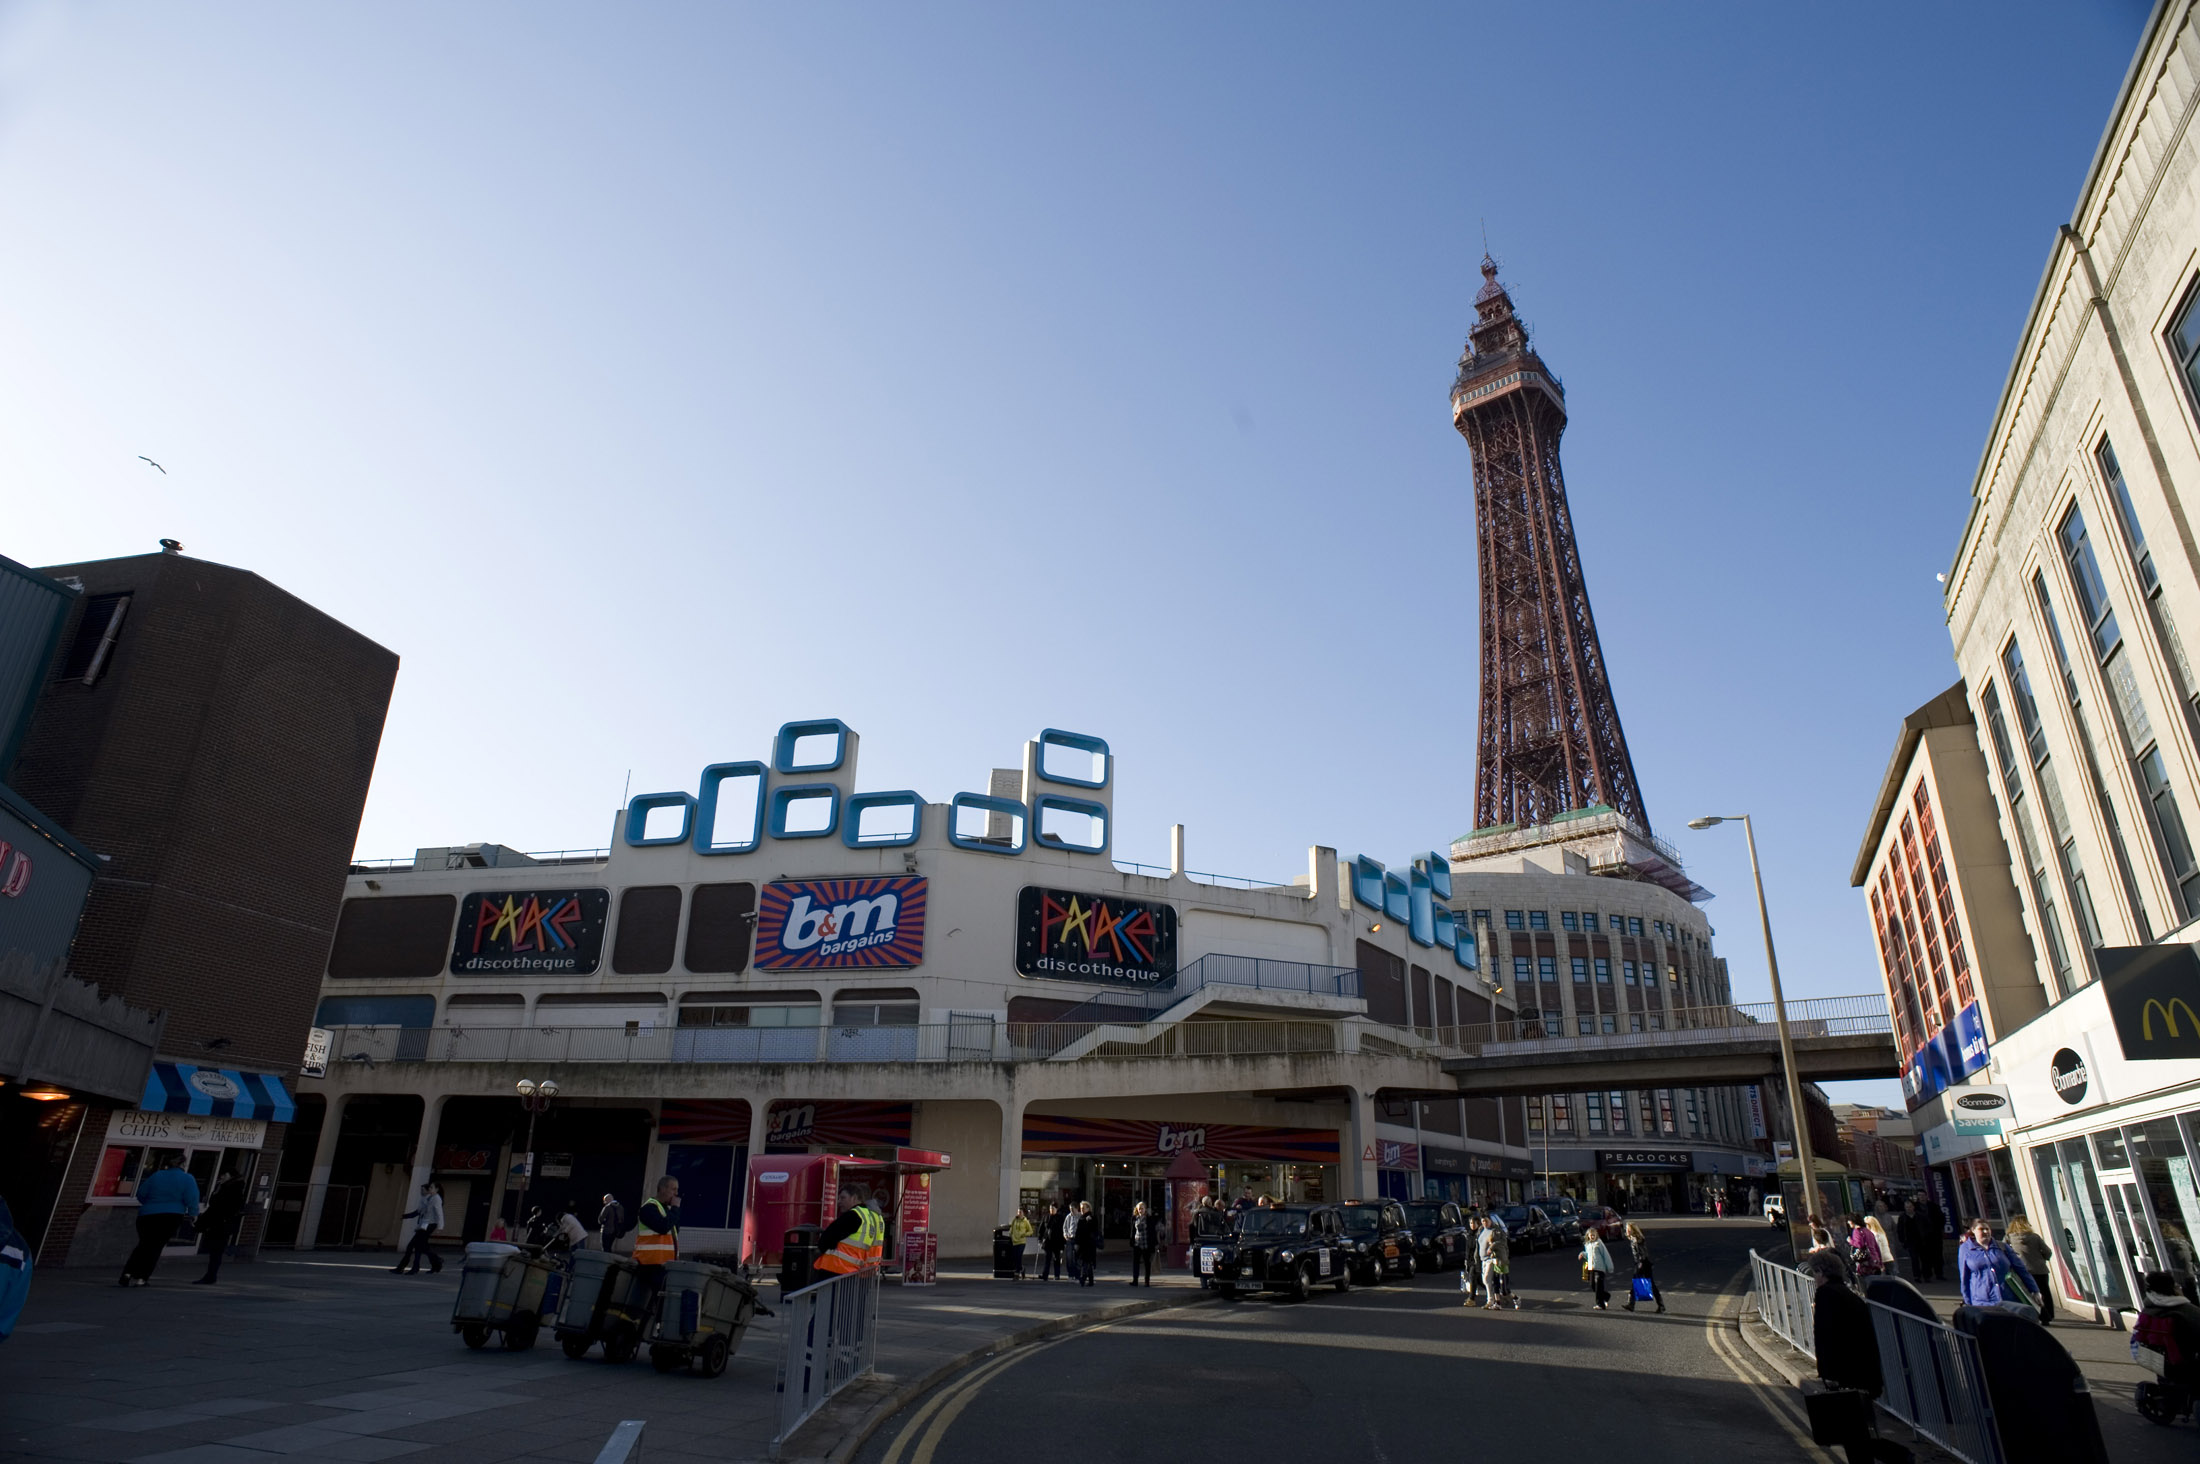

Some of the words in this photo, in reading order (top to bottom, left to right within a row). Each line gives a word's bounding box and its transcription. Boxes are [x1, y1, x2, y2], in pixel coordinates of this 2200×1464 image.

[782, 893, 897, 950] b&m
[819, 930, 895, 956] bargains
[466, 957, 576, 970] discotheque
[1037, 957, 1160, 981] discotheque
[304, 1060, 326, 1072] HIPS
[122, 1111, 160, 1125] FISH
[161, 1114, 172, 1126] &
[120, 1123, 169, 1137] CHIPS
[211, 1130, 233, 1142] TAKE
[233, 1132, 258, 1143] AWAY
[769, 1127, 813, 1142] bargains
[1605, 1153, 1688, 1163] PEACOCKS
